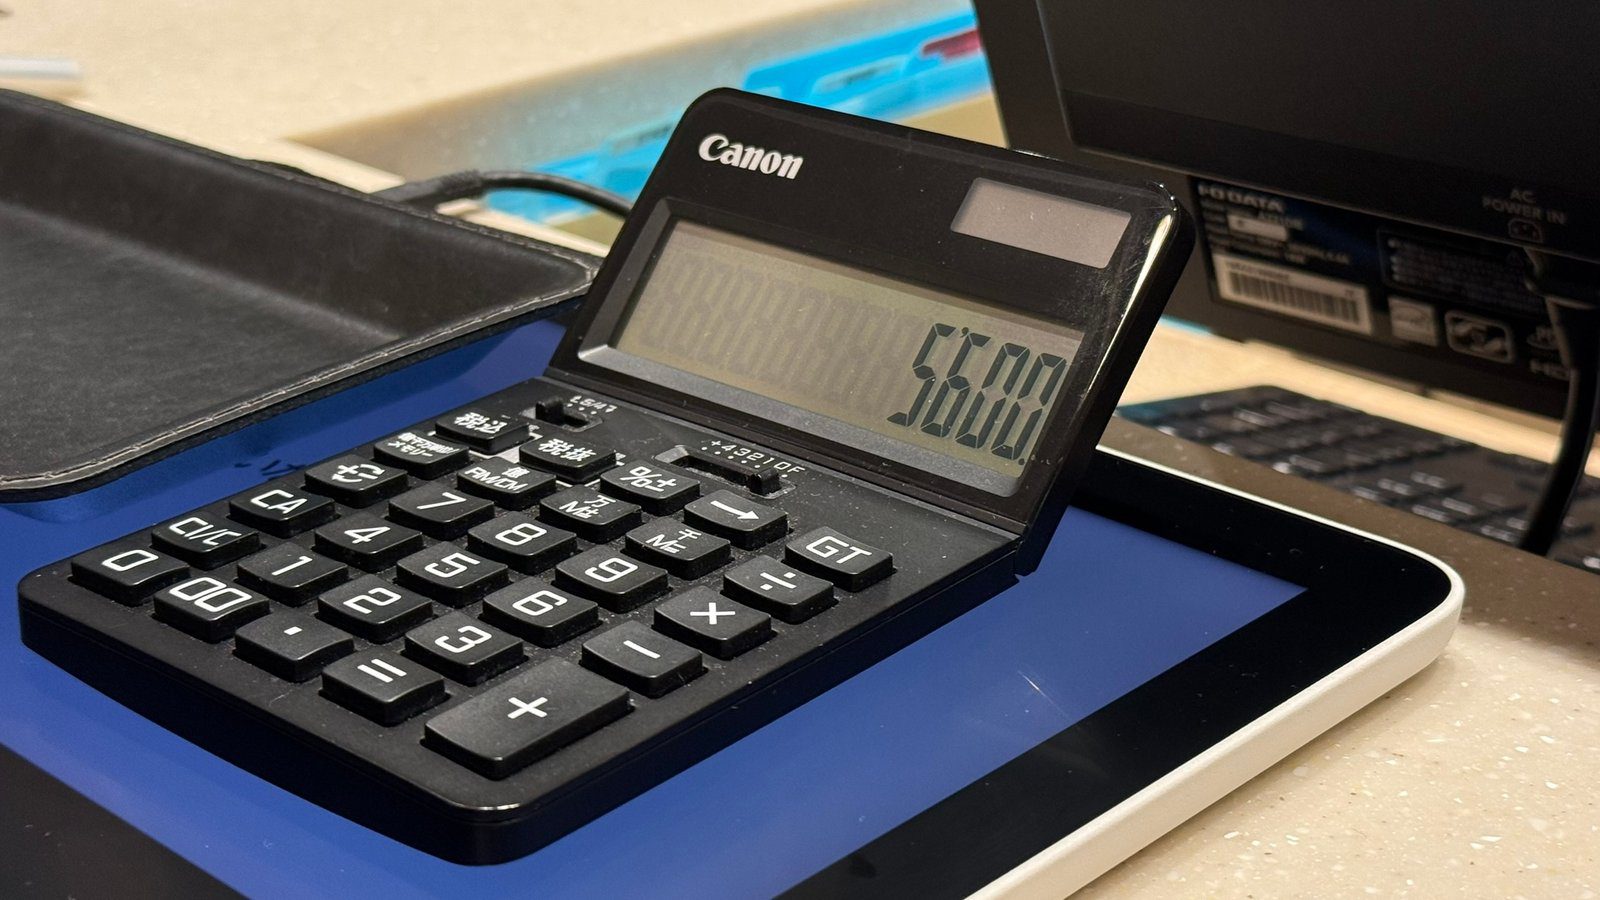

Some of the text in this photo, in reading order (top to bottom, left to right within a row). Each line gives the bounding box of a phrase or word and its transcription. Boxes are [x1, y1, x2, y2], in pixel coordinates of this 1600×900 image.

[699, 134, 803, 179] Canon
[1510, 188, 1535, 203] AC
[1482, 196, 1566, 224] POWER IN
[454, 412, 509, 433] 税込
[538, 439, 597, 461] 税抜
[251, 489, 307, 514] CA
[417, 492, 467, 510] 7
[583, 495, 616, 508] 万
[344, 526, 391, 544] 4
[495, 523, 547, 546] 8
[101, 549, 159, 571] 0
[805, 535, 872, 564] GT
[271, 555, 313, 576] 1
[424, 552, 481, 578] 5
[584, 557, 639, 582] 9
[169, 577, 253, 613] 00
[343, 587, 402, 614] 2
[511, 590, 568, 616] 6
[434, 625, 492, 653] 3
